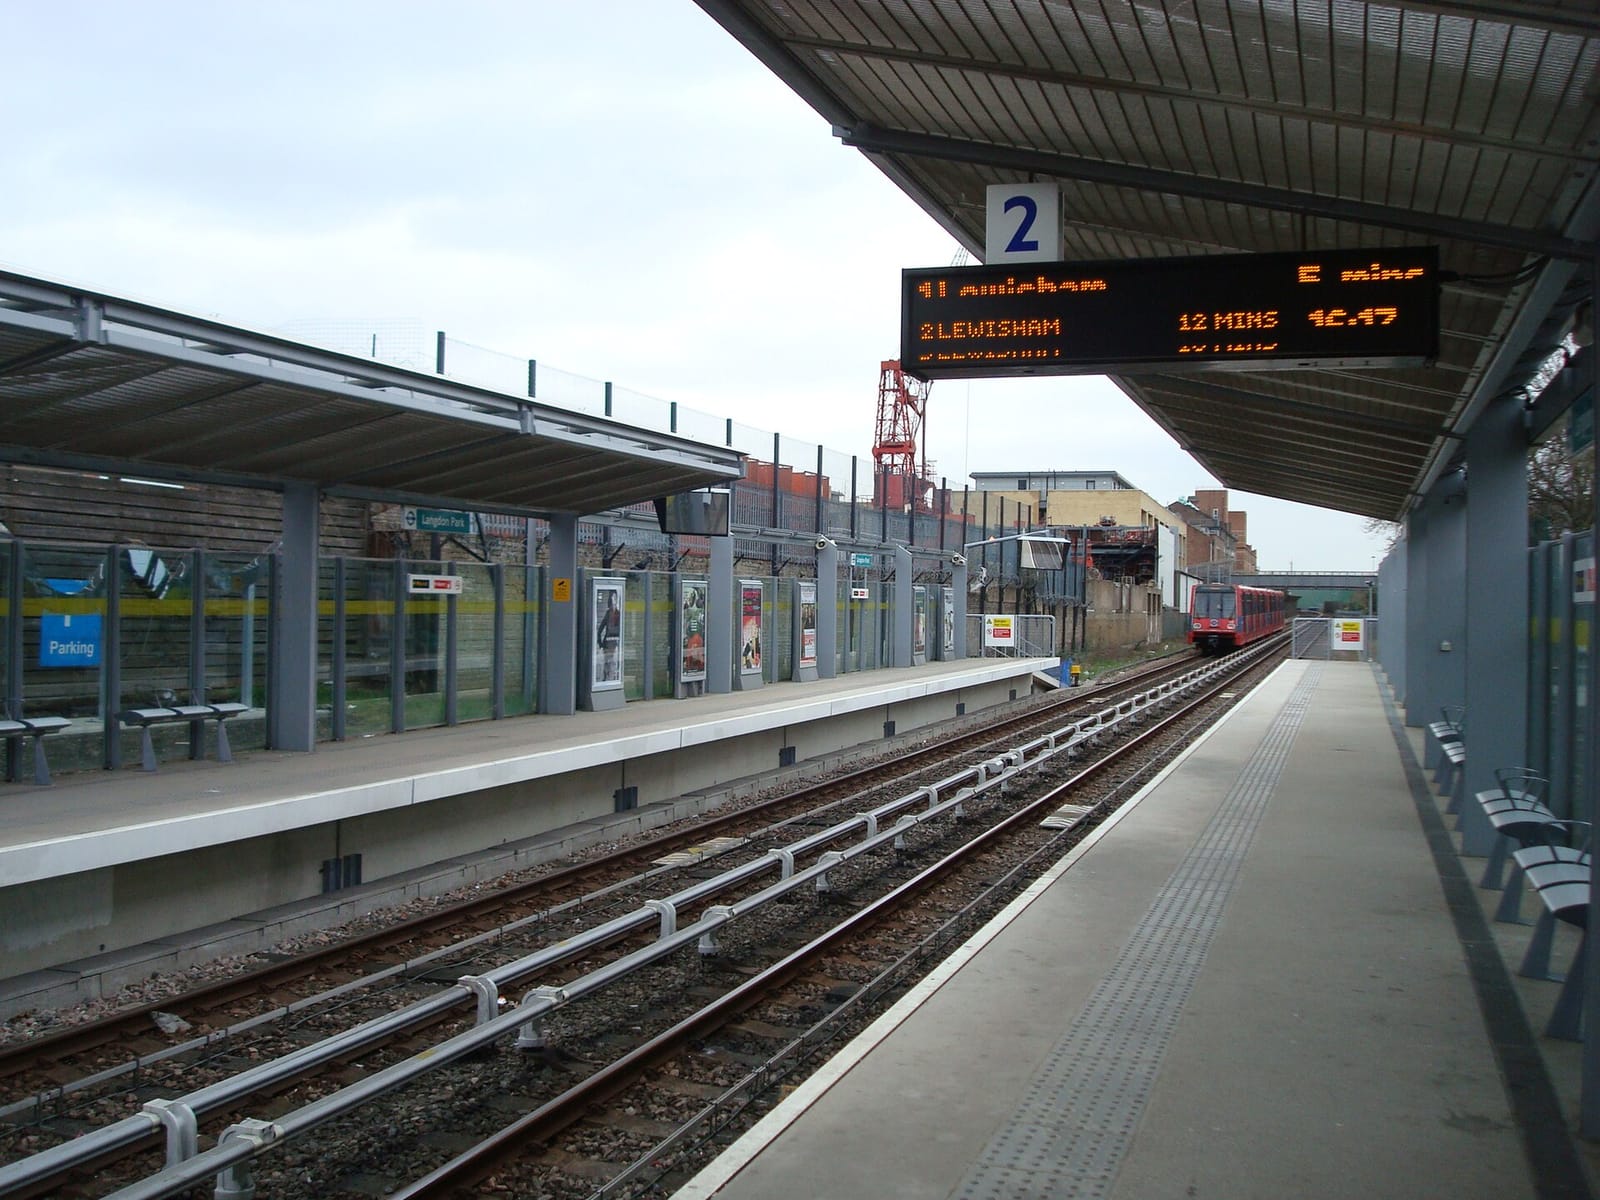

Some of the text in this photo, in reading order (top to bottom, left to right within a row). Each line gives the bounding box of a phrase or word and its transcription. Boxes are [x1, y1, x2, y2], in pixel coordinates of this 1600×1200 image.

[1004, 196, 1039, 253] 2
[920, 318, 1061, 340] 2 LEWISHAM
[1179, 310, 1278, 331] 12 MINS
[421, 514, 465, 528] Langdon Park
[50, 640, 94, 657] Parking
